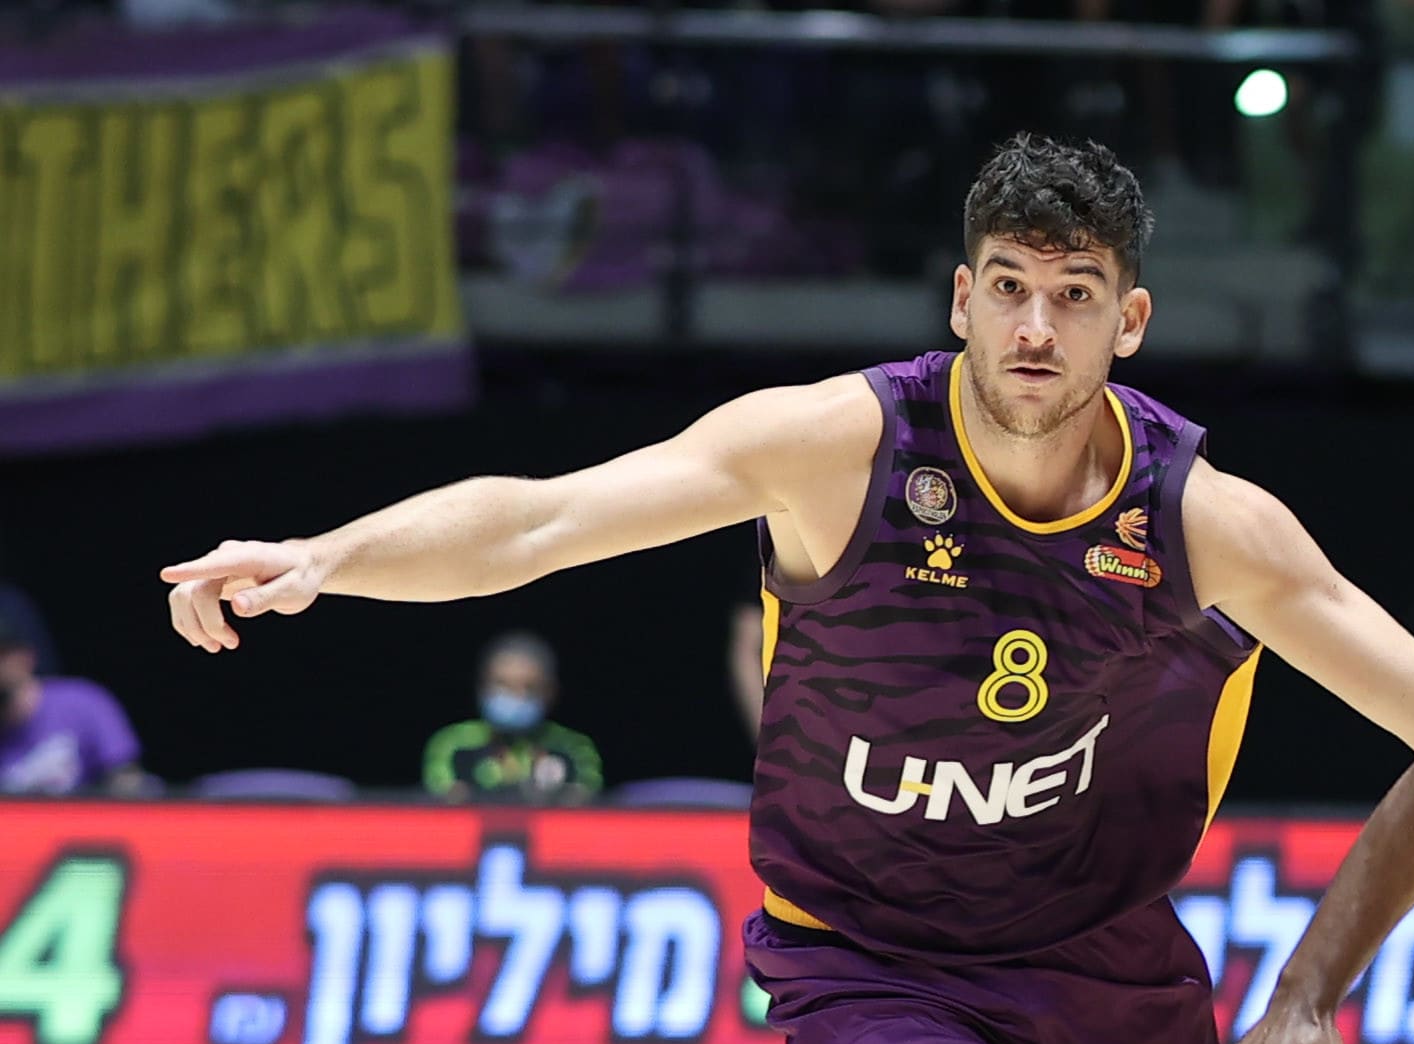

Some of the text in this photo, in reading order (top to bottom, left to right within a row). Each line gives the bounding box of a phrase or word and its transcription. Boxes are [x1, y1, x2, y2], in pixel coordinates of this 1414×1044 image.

[0, 70, 424, 372] THERS
[905, 566, 968, 588] KELME
[976, 629, 1049, 723] 8
